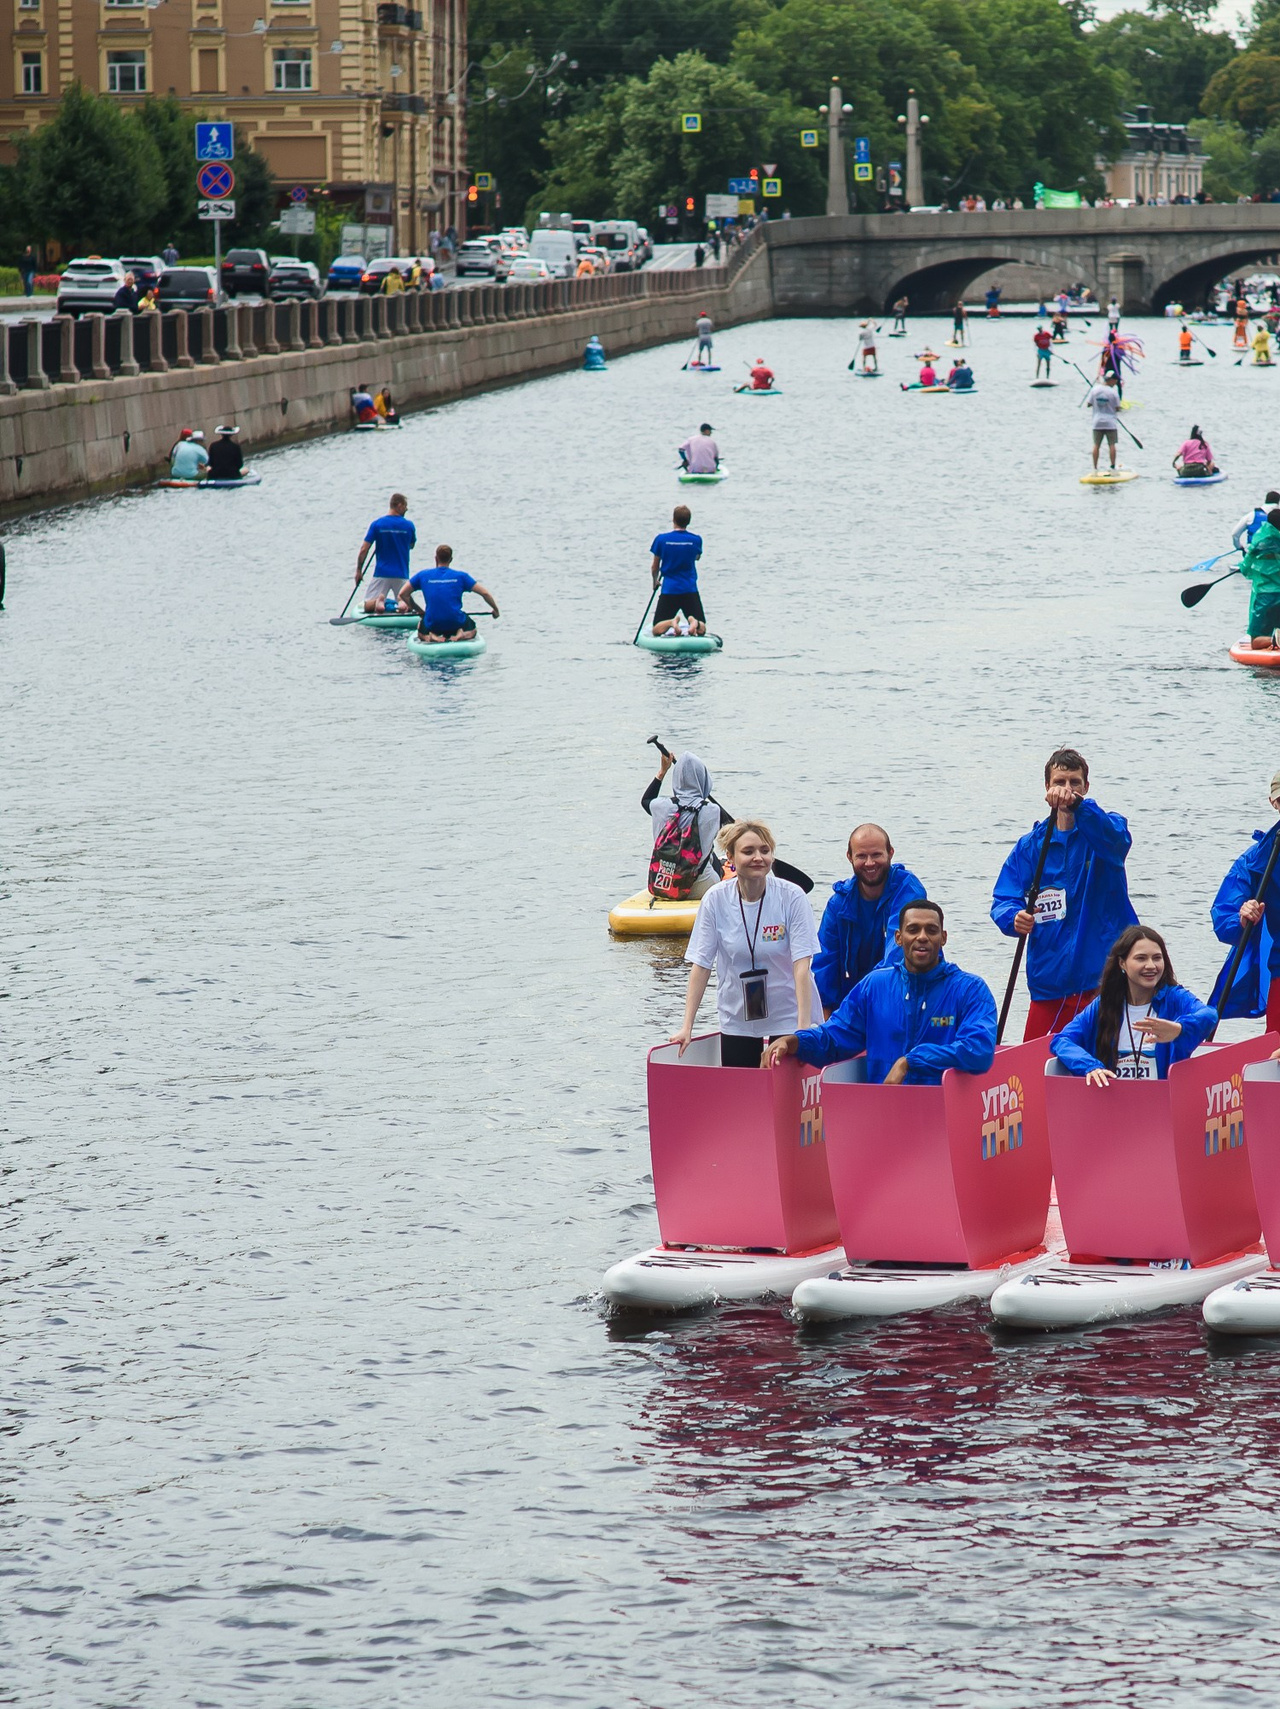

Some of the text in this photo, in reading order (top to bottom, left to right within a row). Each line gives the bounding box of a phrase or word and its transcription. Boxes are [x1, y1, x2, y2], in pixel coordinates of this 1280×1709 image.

[655, 874, 671, 889] 20
[1034, 899, 1063, 913] 2123
[981, 1082, 1019, 1121] УТРО
[1205, 1080, 1240, 1117] УТРО
[800, 1105, 826, 1147] ТН
[981, 1110, 1023, 1161] ТНТ
[1205, 1109, 1244, 1157] ТНТ
